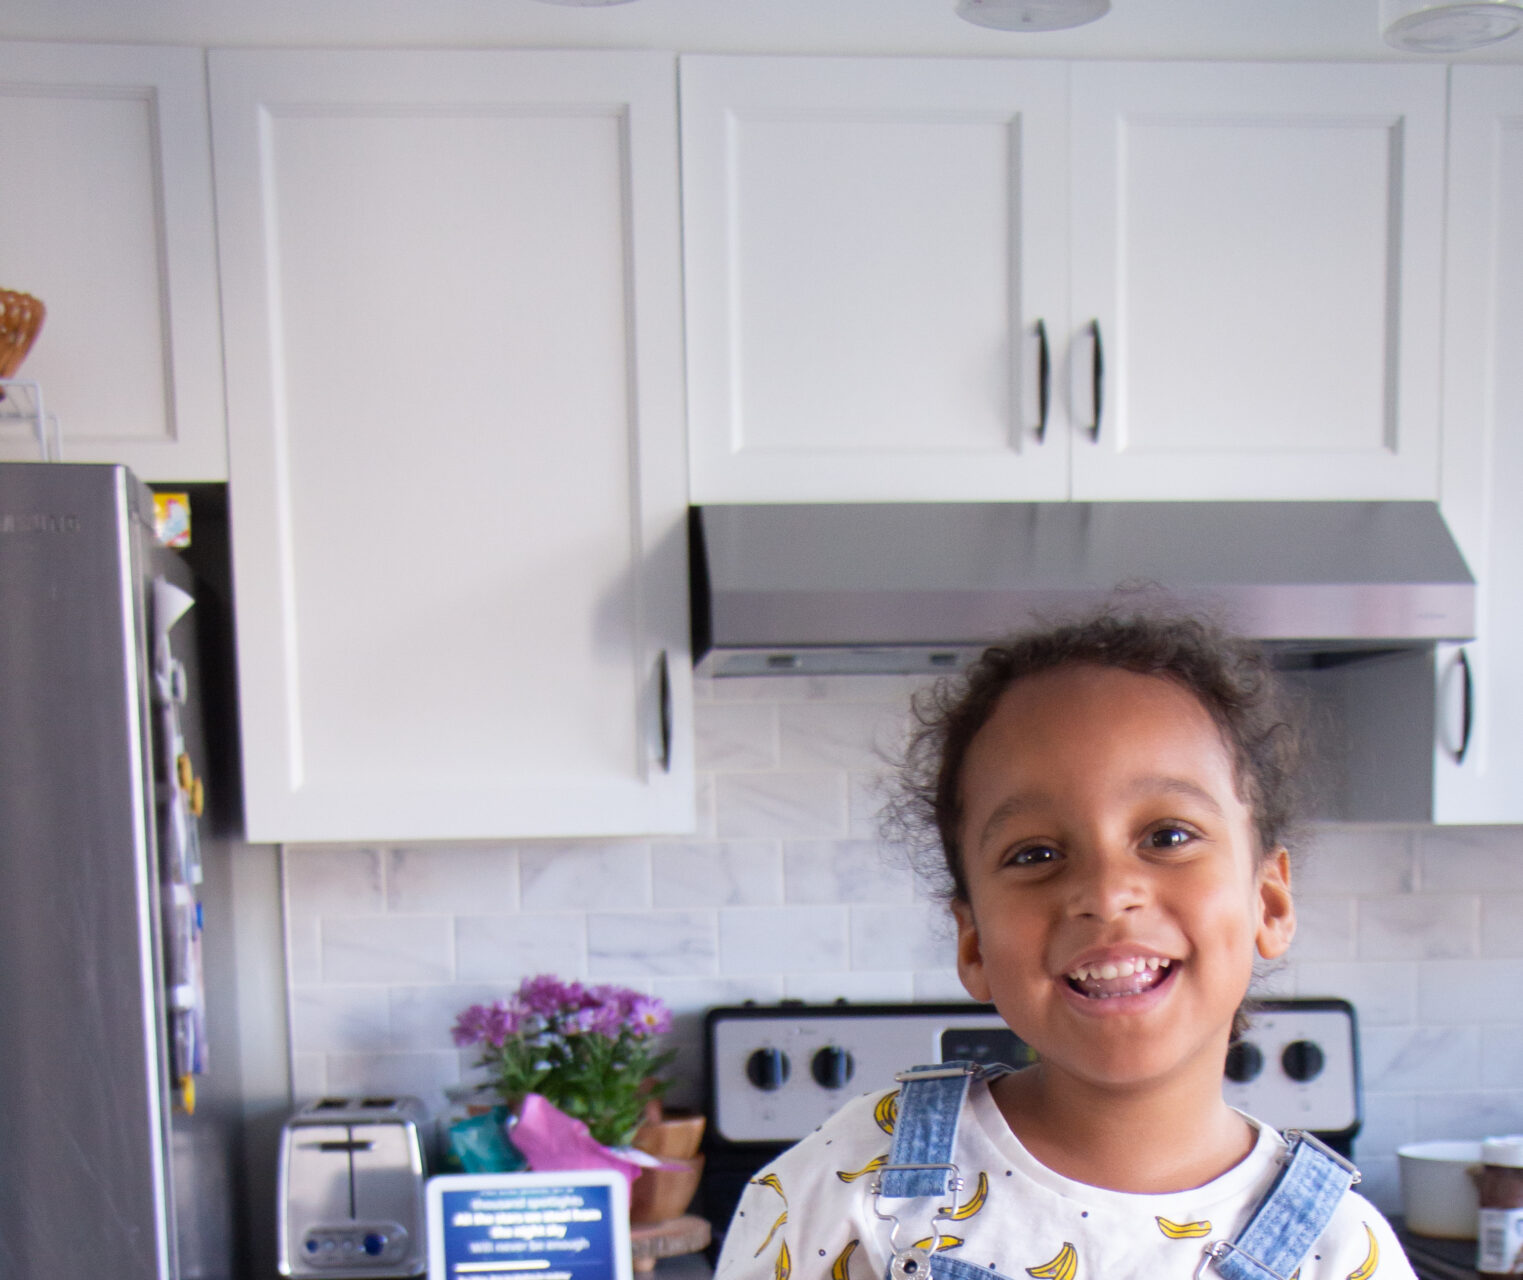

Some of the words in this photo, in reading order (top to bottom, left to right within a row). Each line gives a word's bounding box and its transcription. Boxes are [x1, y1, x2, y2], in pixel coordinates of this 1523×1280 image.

[473, 1211, 494, 1225] the
[572, 1208, 602, 1222] from
[490, 1226, 513, 1239] the
[469, 1241, 494, 1253] Will
[495, 1242, 527, 1253] never
[528, 1240, 544, 1252] be
[545, 1237, 590, 1252] enough
